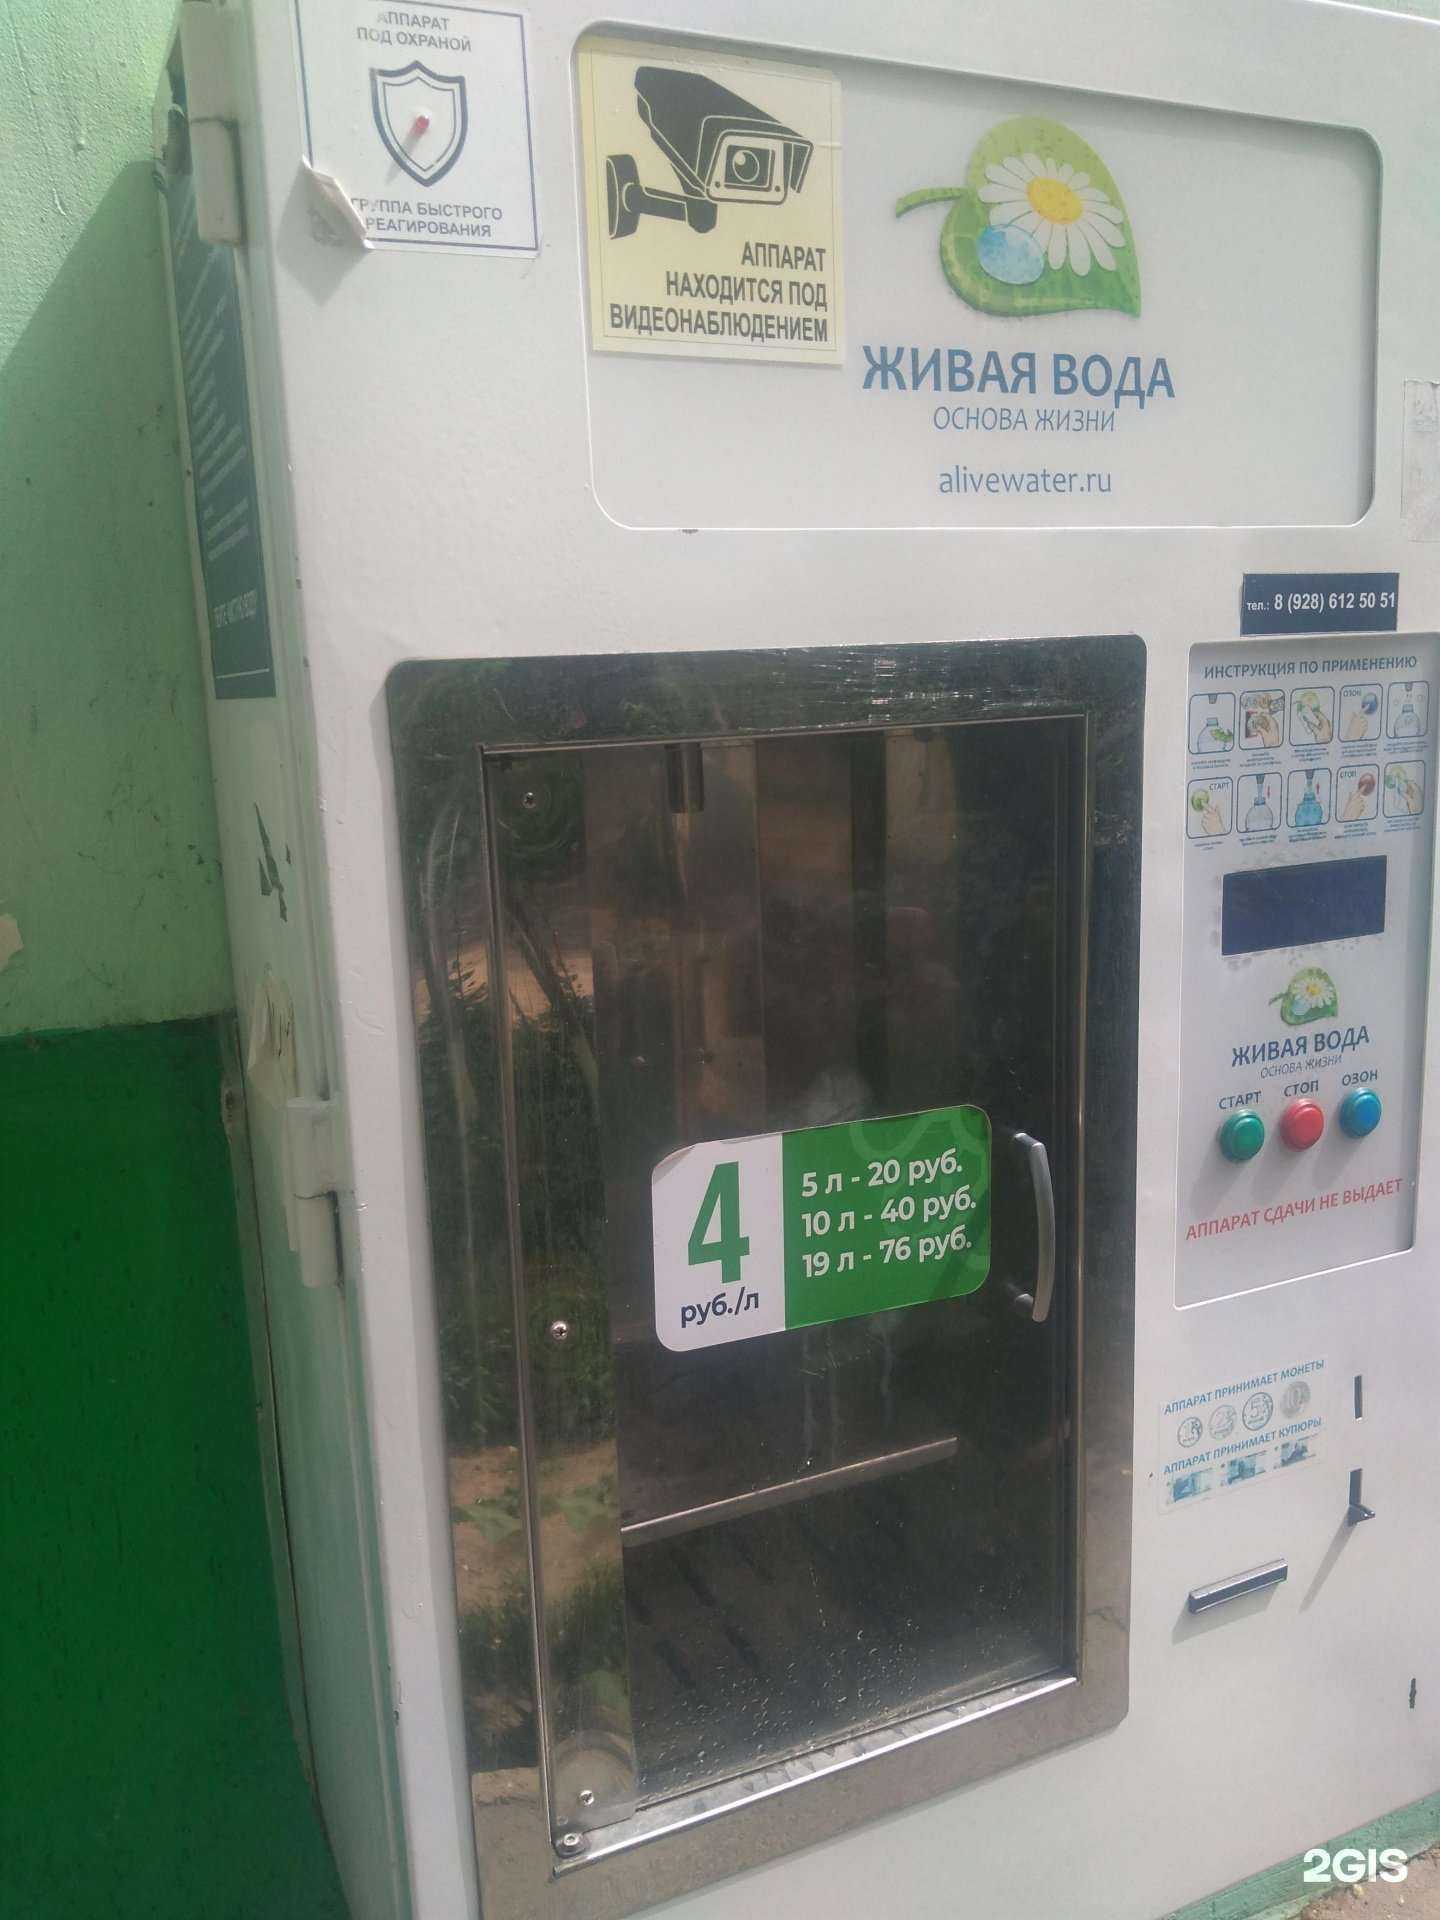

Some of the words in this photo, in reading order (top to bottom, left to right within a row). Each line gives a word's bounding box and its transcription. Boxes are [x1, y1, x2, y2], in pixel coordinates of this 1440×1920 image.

[377, 12, 450, 31] АППАРАТ
[357, 27, 393, 46] ПОД
[396, 32, 472, 52] ОХРАНОЙ
[417, 201, 502, 221] БЫСТРОГО
[366, 217, 491, 238] РЕАГИРОВАНИЯ
[741, 241, 826, 272] АППАРАТ
[665, 271, 783, 305] НАХОДИТСЯ
[789, 281, 828, 312] ПОД
[609, 302, 828, 343] ВИДЕОНАБЛЮДЕНИЕМ
[862, 345, 1037, 394] ЖИВАЯ
[1053, 353, 1176, 410] ВОДА
[933, 406, 1028, 431] ОСНОВА
[1035, 409, 1116, 432] ЖИЗНИ
[939, 465, 1112, 493] alivewater.ru
[1246, 601, 1270, 611] тел.:
[1274, 593, 1283, 611] 8
[1287, 593, 1325, 614] (928)
[1328, 592, 1355, 609] 612
[1358, 592, 1375, 608] 50
[1380, 592, 1395, 608] 51
[1204, 662, 1295, 680] ИНСТРУКЦИЯ
[1299, 660, 1319, 674] ПО
[1322, 655, 1417, 673] ПРИМЕНЕНИЮ
[1209, 781, 1230, 792] СТАРТ
[1231, 1035, 1307, 1067] ЖИВАЯ
[1313, 1025, 1370, 1053] ВОДА
[1260, 1061, 1302, 1079] ОСНОВА
[1305, 1054, 1343, 1071] ЖИЗНИ
[1341, 1069, 1379, 1087] ОЗОН
[1218, 1090, 1262, 1110] СТАРТ
[1283, 1080, 1320, 1098] СТОП
[802, 1172, 818, 1197] 5
[824, 1174, 843, 1194] л
[866, 1158, 901, 1187] 20
[908, 1147, 962, 1186] руб.
[687, 1160, 750, 1284] 4
[801, 1210, 831, 1238] 10
[837, 1210, 855, 1232] л
[880, 1196, 916, 1223] 40
[923, 1184, 977, 1223] руб.
[1185, 1210, 1261, 1241] АППАРАТ
[1263, 1197, 1316, 1225] СДАЧИ
[1319, 1192, 1339, 1210] НЕ
[1342, 1178, 1403, 1206] ВЫДАЕТ
[801, 1251, 830, 1278] 19
[836, 1251, 855, 1273] л
[879, 1236, 912, 1265] 76
[918, 1224, 973, 1263] руб.
[680, 1286, 760, 1328] руб./л
[1163, 1391, 1213, 1415] АППАРАТ
[1214, 1372, 1278, 1400] ПРИНИМАЕТ
[1280, 1359, 1325, 1381] МОНЕТЫ
[1163, 1452, 1212, 1475] АППАРАТ
[1212, 1430, 1277, 1459] ПРИНИМАЕТ
[1278, 1417, 1322, 1439] КУПЮРЫ
